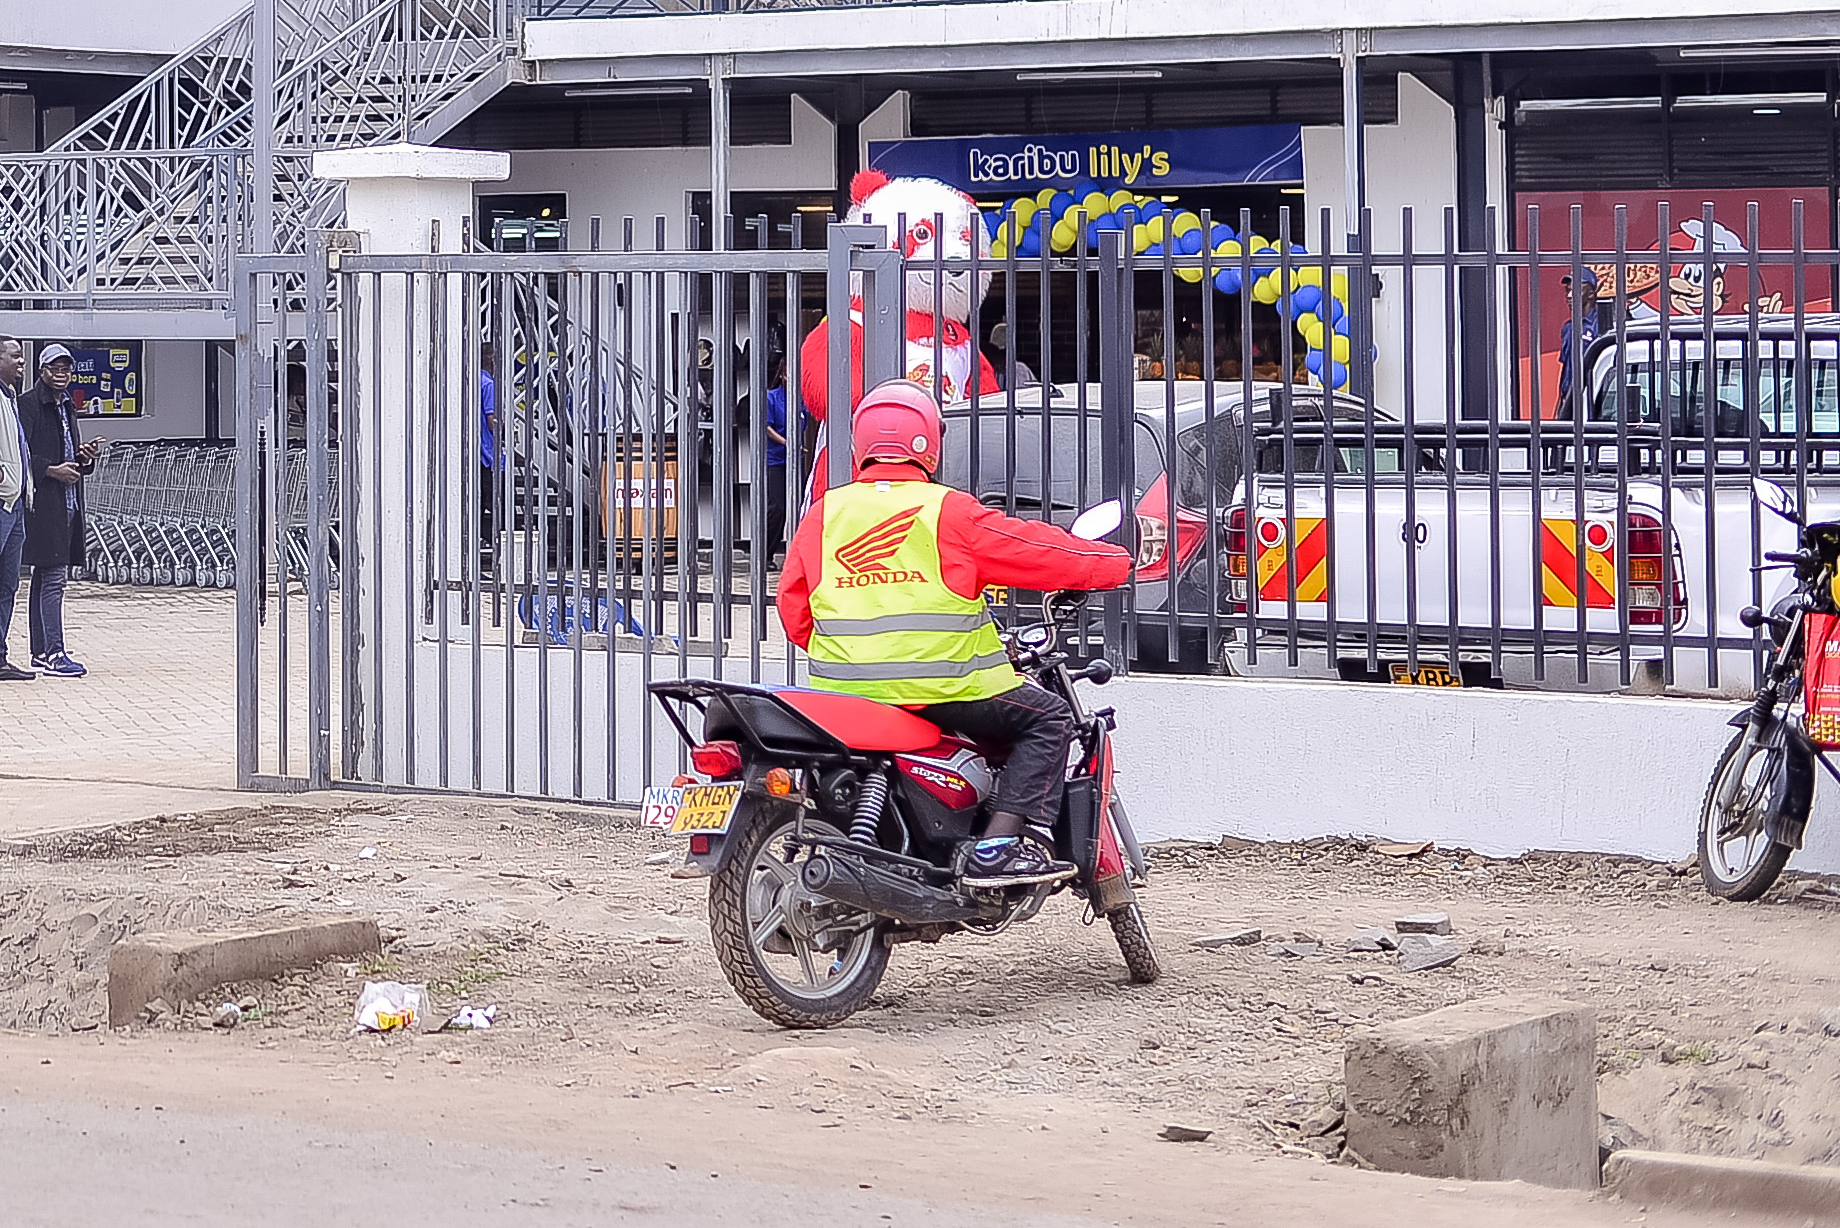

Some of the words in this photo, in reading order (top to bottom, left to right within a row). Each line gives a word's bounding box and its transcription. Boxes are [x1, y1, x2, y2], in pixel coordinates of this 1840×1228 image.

[969, 143, 1080, 182] karibu
[1089, 144, 1171, 185] lily's
[834, 569, 930, 589] HONDA
[647, 787, 681, 807] MKR
